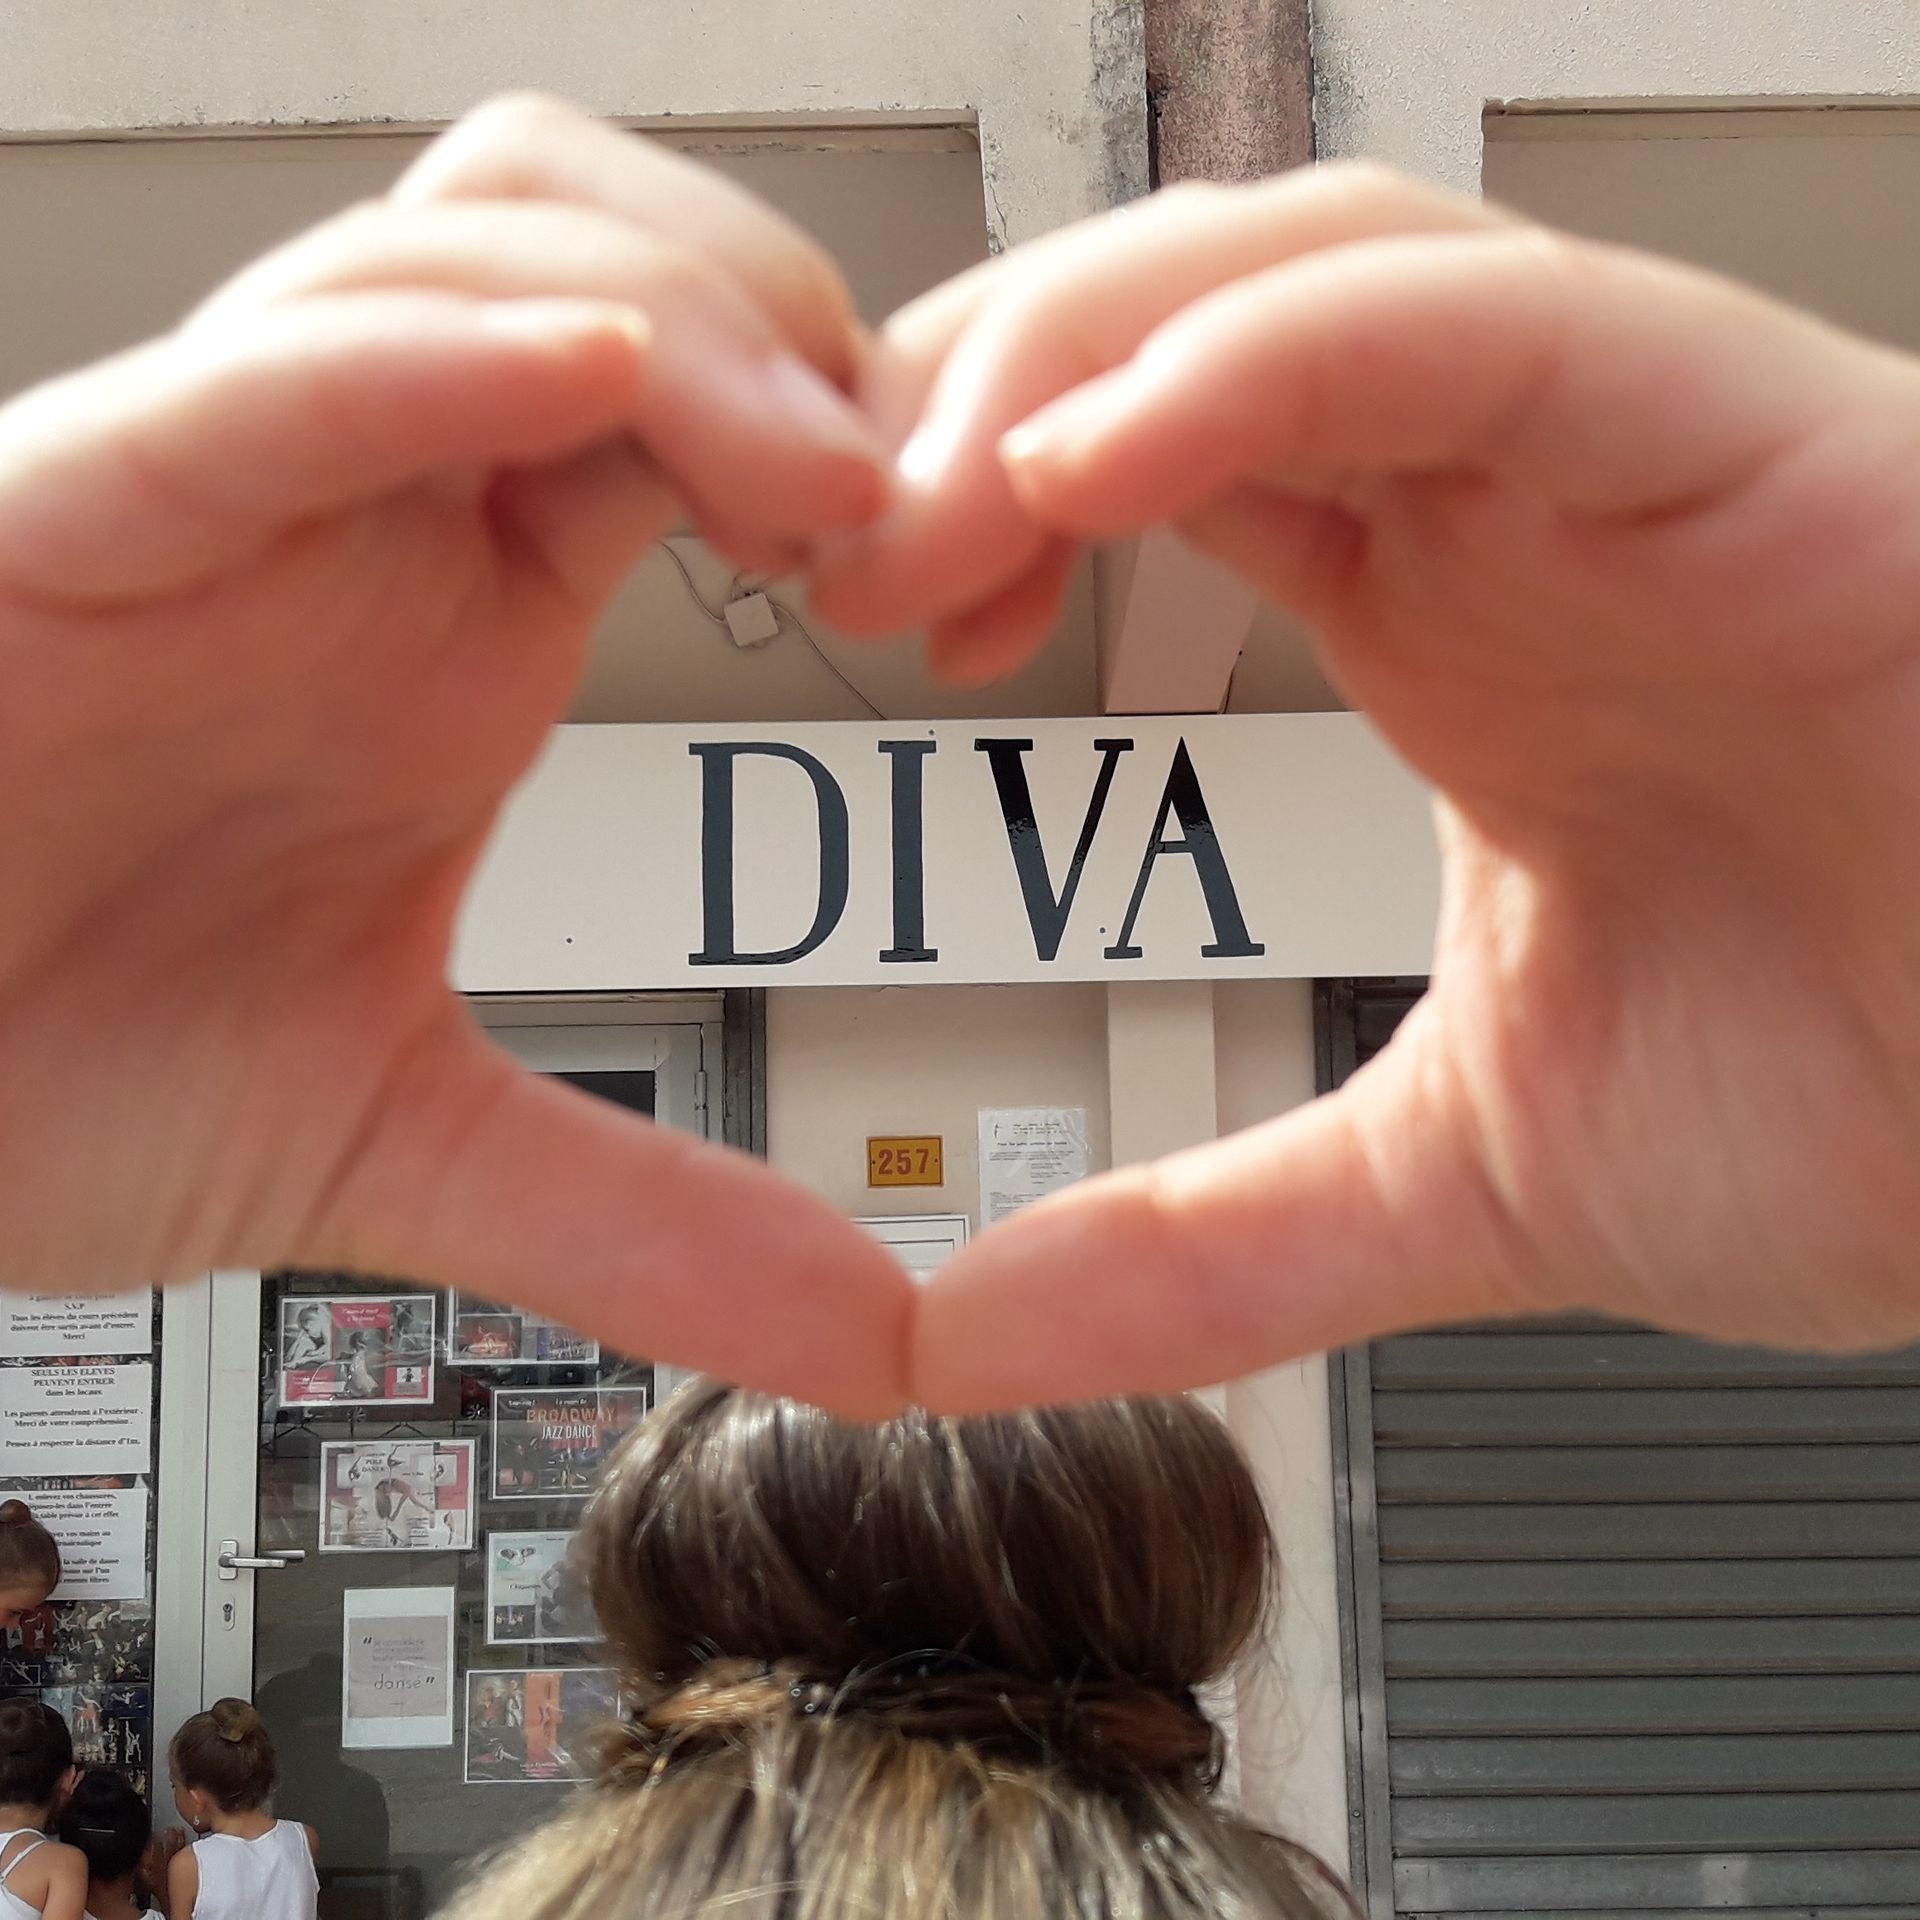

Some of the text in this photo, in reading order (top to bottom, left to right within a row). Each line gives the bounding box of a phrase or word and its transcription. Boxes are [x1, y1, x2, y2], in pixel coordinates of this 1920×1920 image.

[689, 736, 1265, 965] DIVA
[878, 1149, 929, 1175] 257
[20, 1410, 48, 1418] parents
[527, 1408, 615, 1423] BROADWAY
[541, 1424, 597, 1439] JAZZ DANCE
